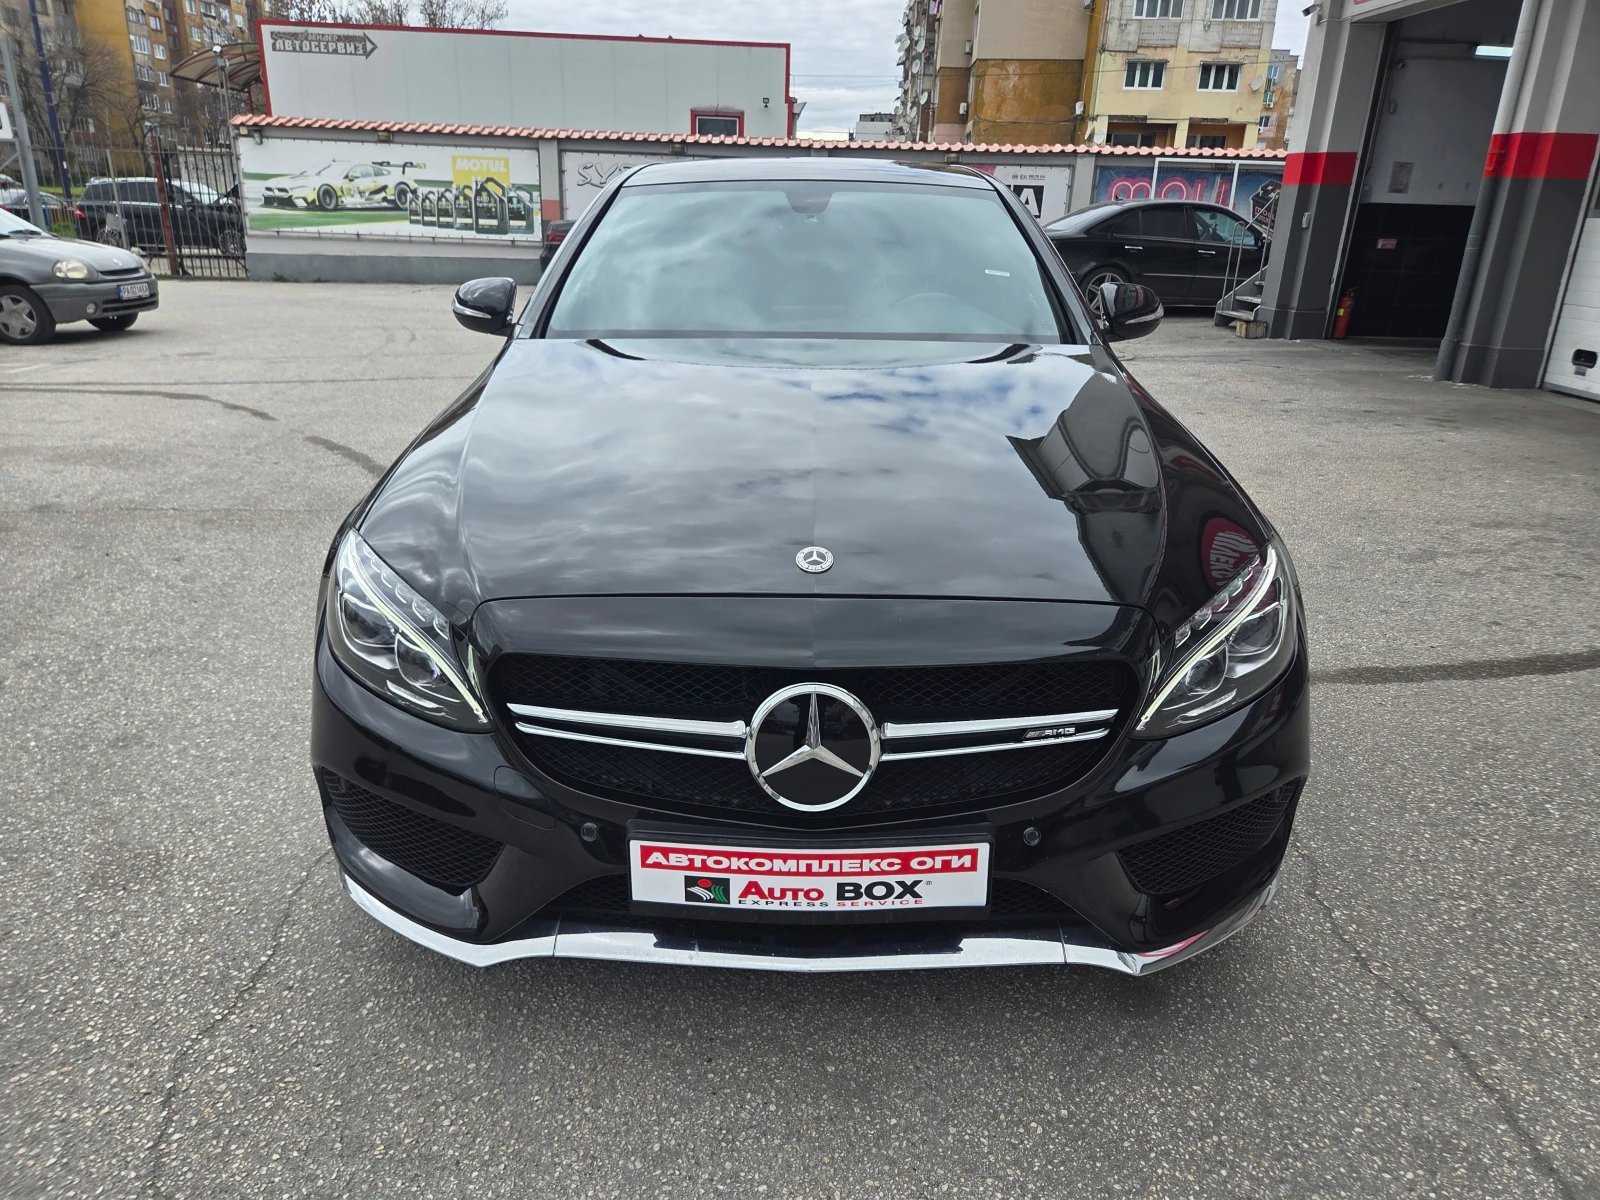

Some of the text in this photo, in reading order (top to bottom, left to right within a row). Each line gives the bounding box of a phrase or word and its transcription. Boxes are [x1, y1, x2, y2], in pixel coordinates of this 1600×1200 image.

[275, 39, 364, 54] АВТОСЕРВИЗ
[455, 158, 507, 173] MOTUL
[645, 851, 972, 872] АВТОКОМПЛЕКС ОГИ
[836, 880, 924, 901] BOX
